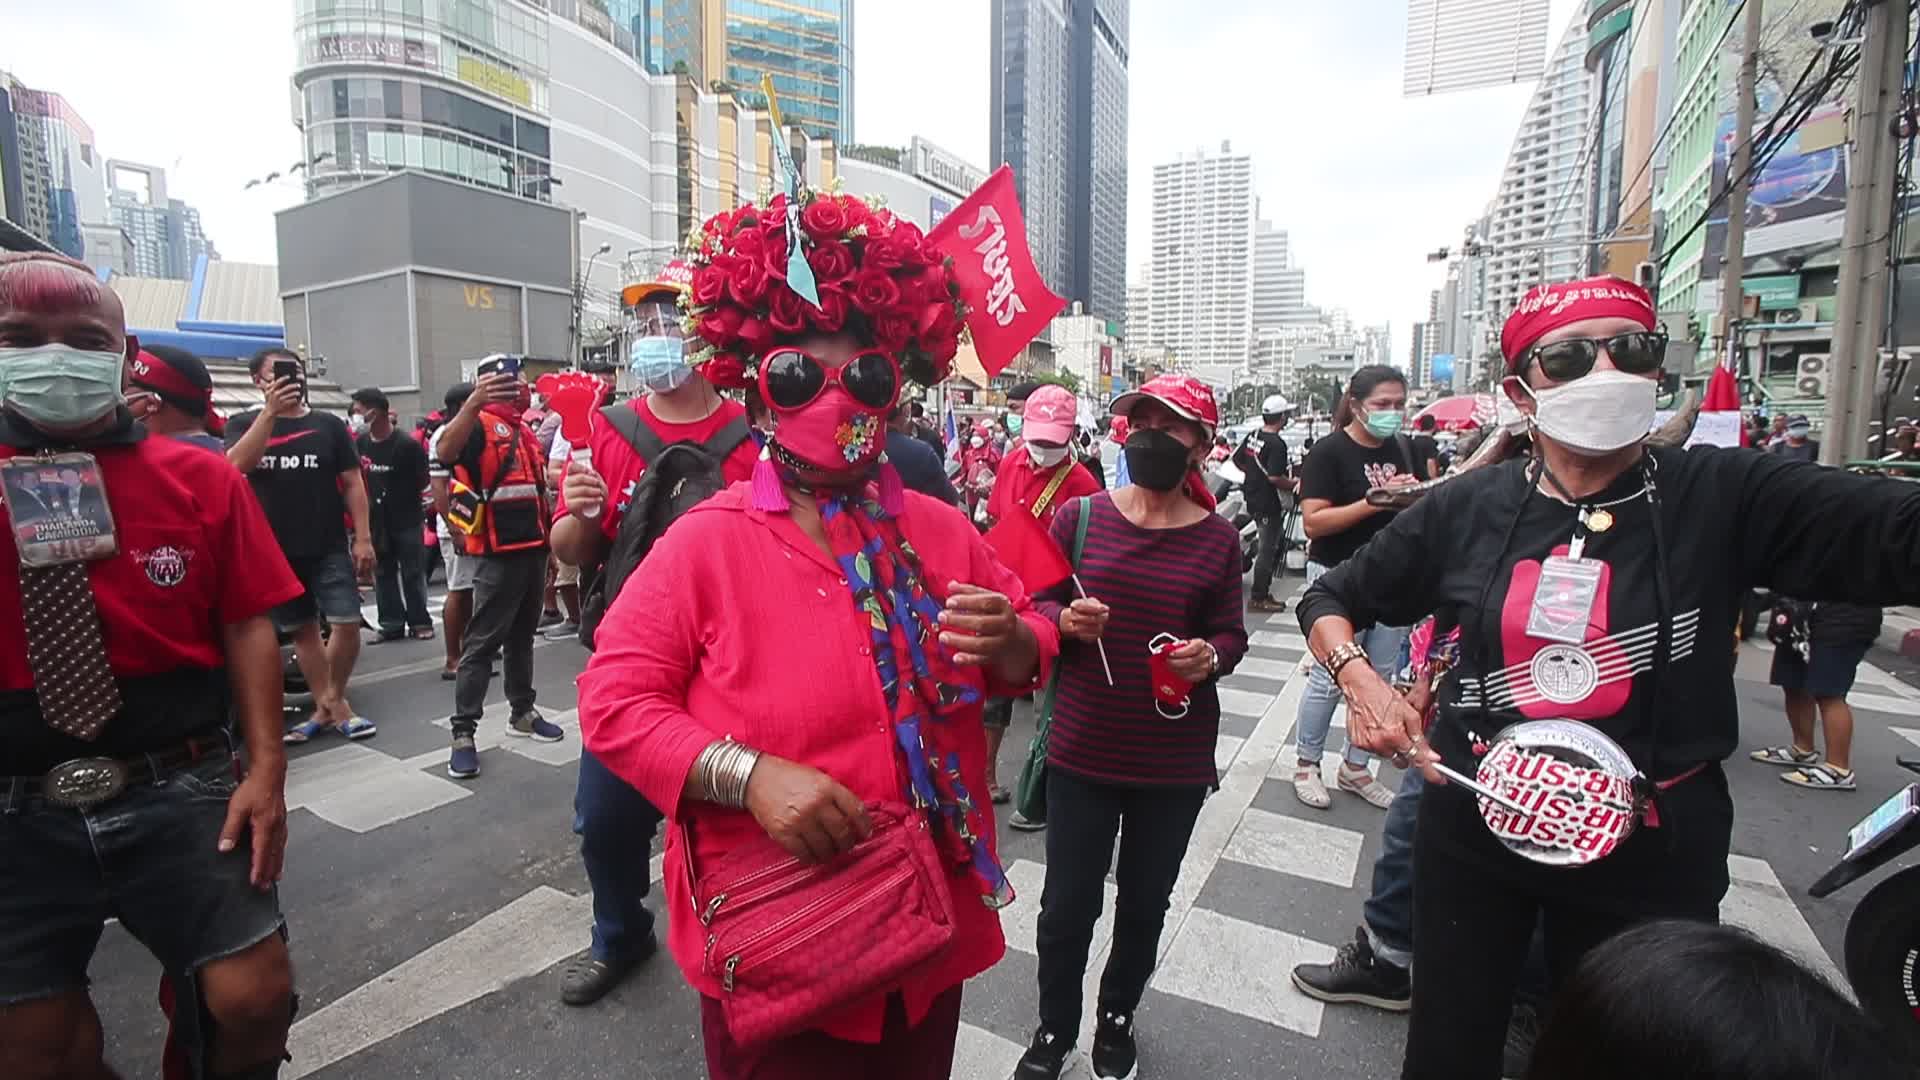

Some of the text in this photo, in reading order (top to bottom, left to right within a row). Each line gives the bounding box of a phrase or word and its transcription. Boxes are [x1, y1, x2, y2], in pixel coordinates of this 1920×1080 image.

[463, 285, 496, 309] VS
[280, 456, 300, 470] DO
[36, 526, 100, 541] CAMBODIA
